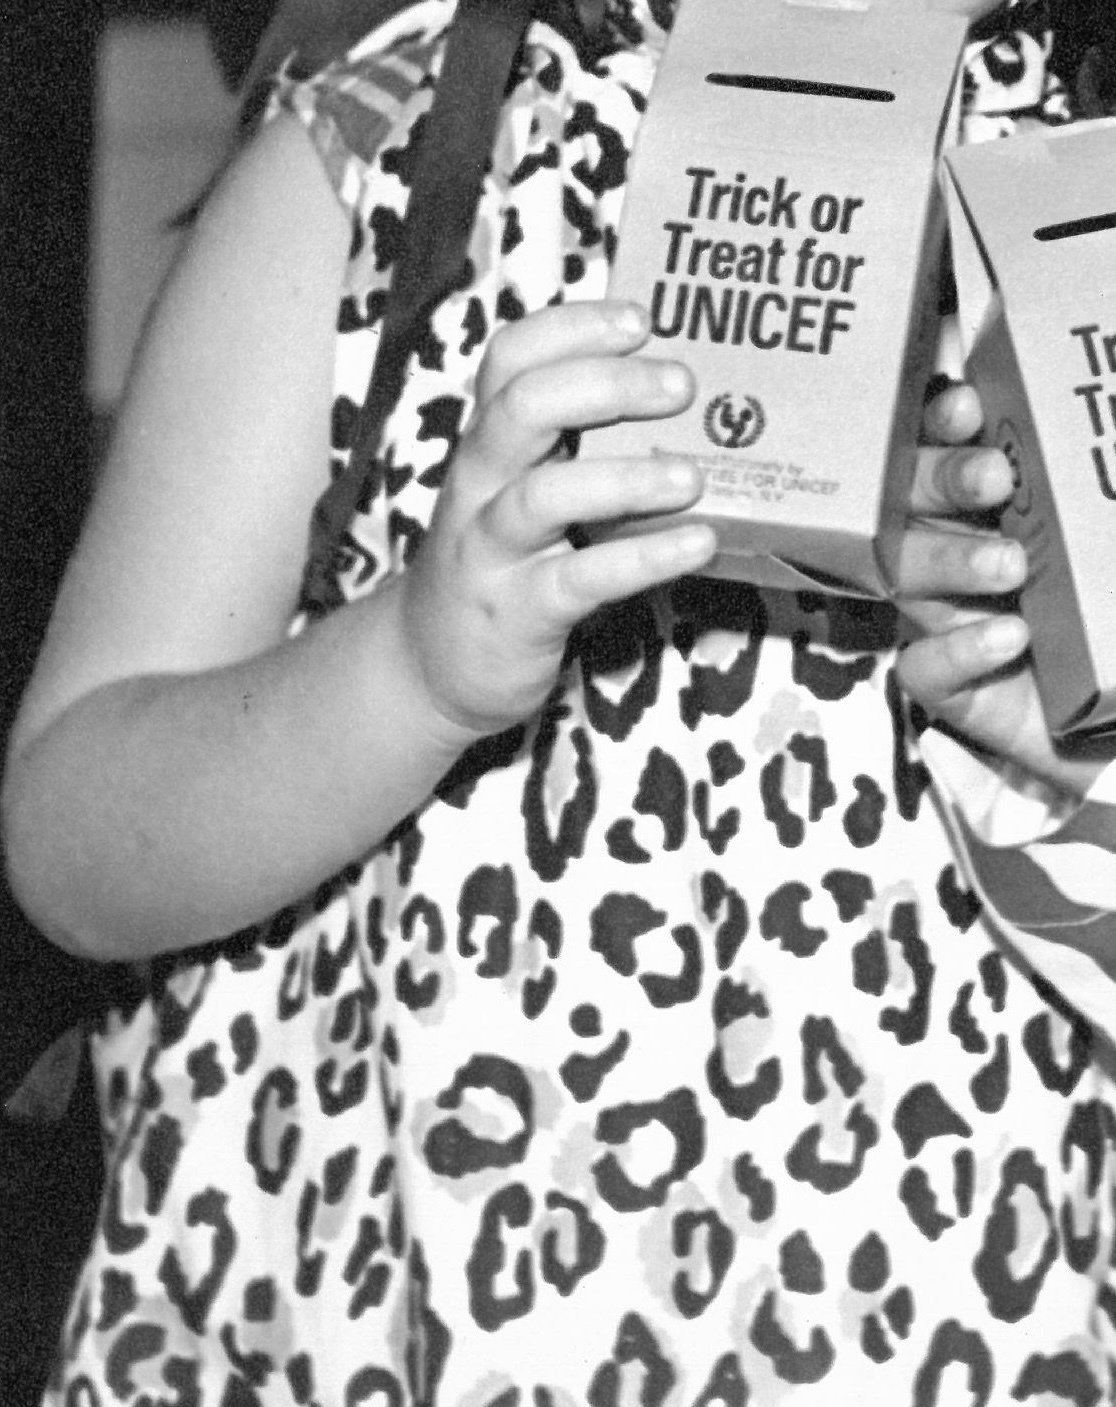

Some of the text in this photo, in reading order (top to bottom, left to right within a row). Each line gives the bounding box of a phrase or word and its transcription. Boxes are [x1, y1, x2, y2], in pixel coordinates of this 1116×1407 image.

[686, 167, 865, 234] Trick or
[663, 222, 865, 293] Treat for
[651, 281, 856, 355] UNICEF
